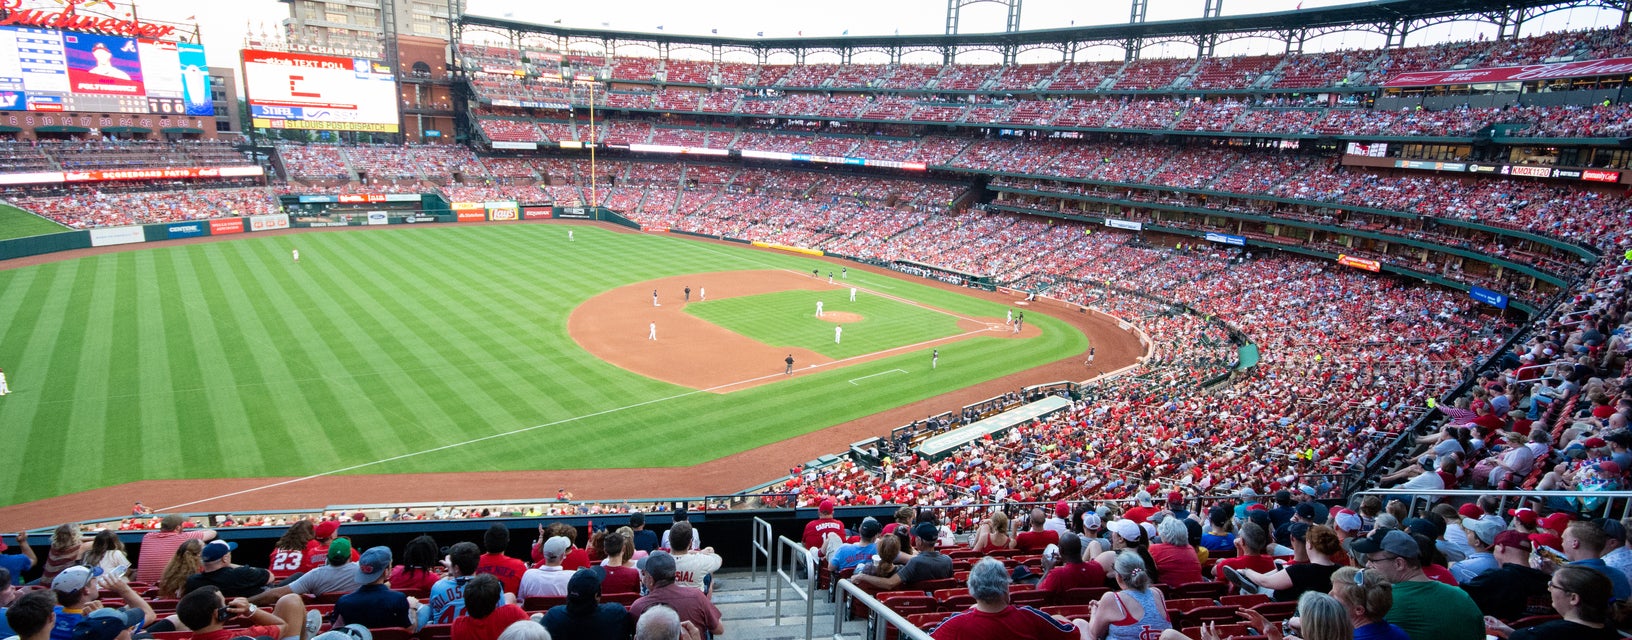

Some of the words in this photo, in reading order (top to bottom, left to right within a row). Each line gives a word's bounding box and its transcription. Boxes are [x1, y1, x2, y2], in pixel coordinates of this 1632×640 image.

[309, 44, 378, 58] CHAMPIONS
[293, 59, 319, 67] TEXT
[322, 61, 345, 70] POLL
[150, 103, 158, 112] 1
[162, 103, 172, 113] 0
[174, 103, 184, 113] 0
[262, 106, 294, 116] STIFEL
[61, 116, 73, 126] 14
[80, 117, 92, 126] 17
[300, 120, 324, 129] LOUIS
[164, 169, 190, 177] PATIO
[272, 552, 303, 571] 23
[675, 571, 694, 583] SIAL
